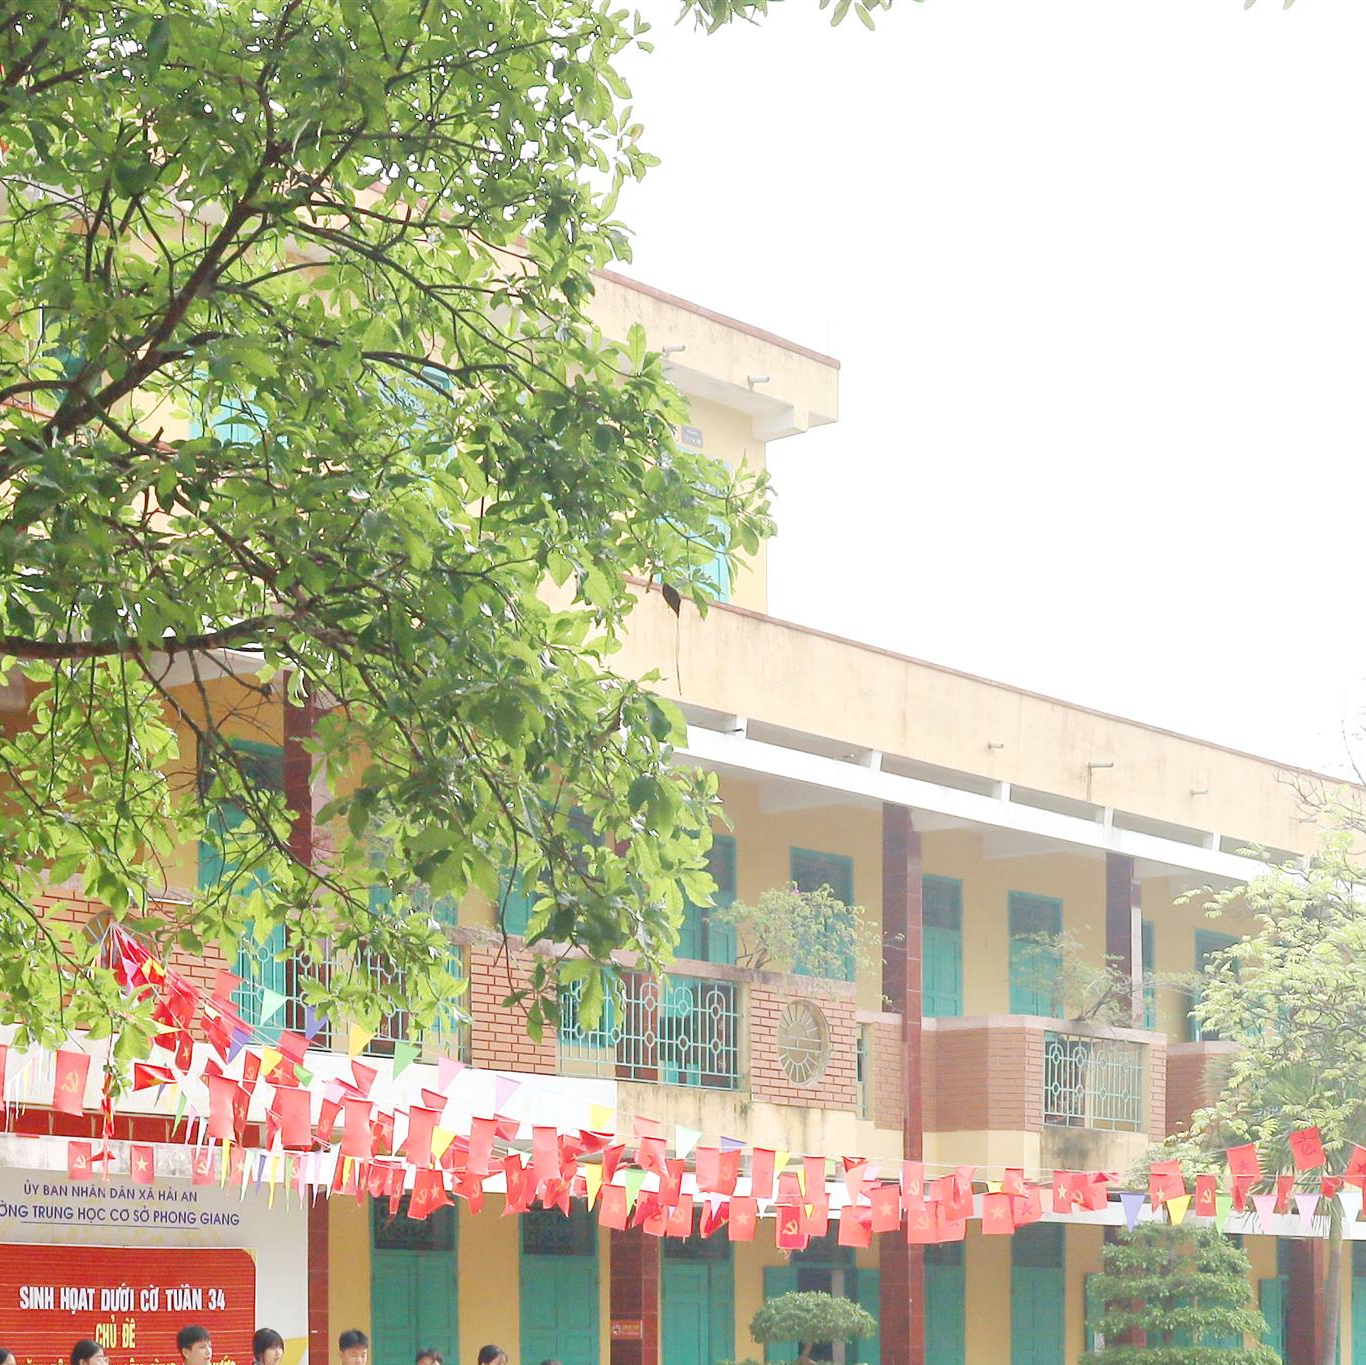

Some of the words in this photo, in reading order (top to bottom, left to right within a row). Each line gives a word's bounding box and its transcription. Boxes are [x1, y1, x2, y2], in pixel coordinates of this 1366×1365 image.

[24, 1179, 39, 1195] ỦY
[43, 1184, 68, 1196] BAN
[71, 1184, 106, 1198] NHÂN
[110, 1185, 135, 1199] DÂN
[138, 1187, 155, 1200] XÃ
[158, 1186, 177, 1201] HẢI
[181, 1191, 197, 1202] AN
[32, 1205, 74, 1219] TRUNG
[77, 1207, 106, 1223] HỌC
[110, 1208, 129, 1221] CƠ
[133, 1205, 150, 1223] SỞ
[153, 1210, 196, 1224] PHONG
[200, 1212, 240, 1225] GIANG
[19, 1285, 55, 1310] SINH
[101, 1281, 135, 1312] DƯỚI
[140, 1284, 159, 1312] CỜ
[165, 1283, 203, 1312] TUẦN
[208, 1288, 226, 1311] 34
[95, 1314, 117, 1348] CHỦ
[122, 1317, 136, 1348] ĐỀ
